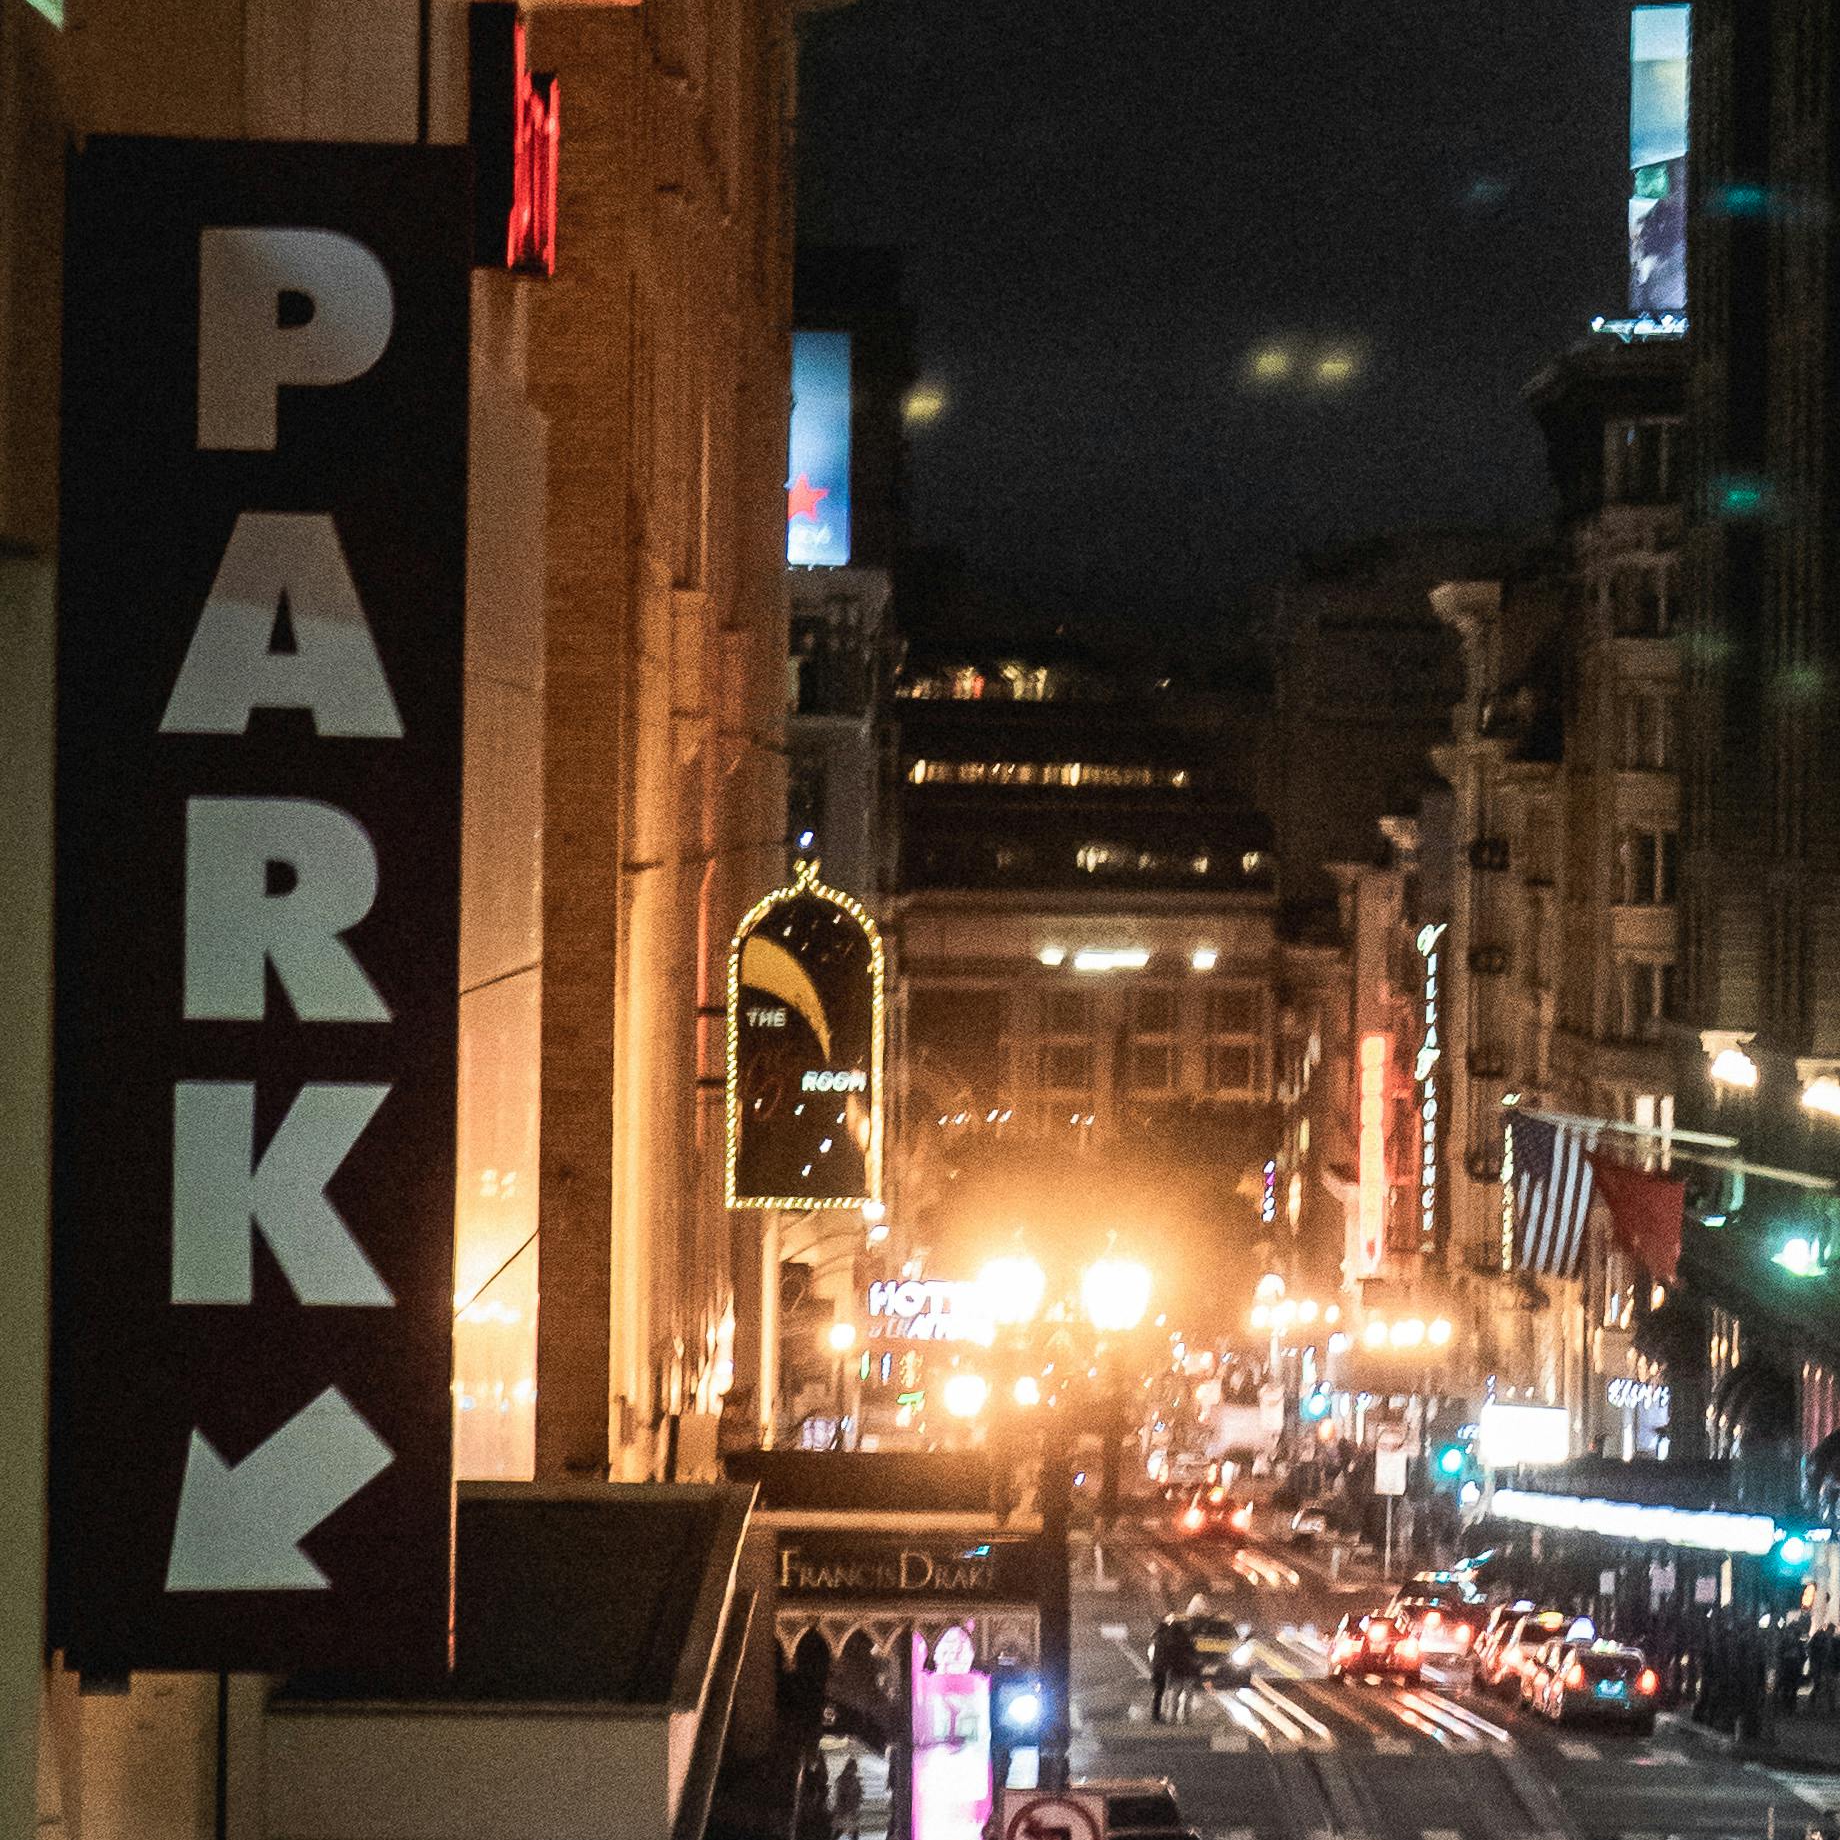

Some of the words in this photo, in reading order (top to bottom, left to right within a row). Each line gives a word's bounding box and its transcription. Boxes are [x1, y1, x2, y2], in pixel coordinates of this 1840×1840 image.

[157, 225, 405, 1307] PARK
[745, 1007, 788, 1028] THE
[800, 1069, 868, 1093] ROOM
